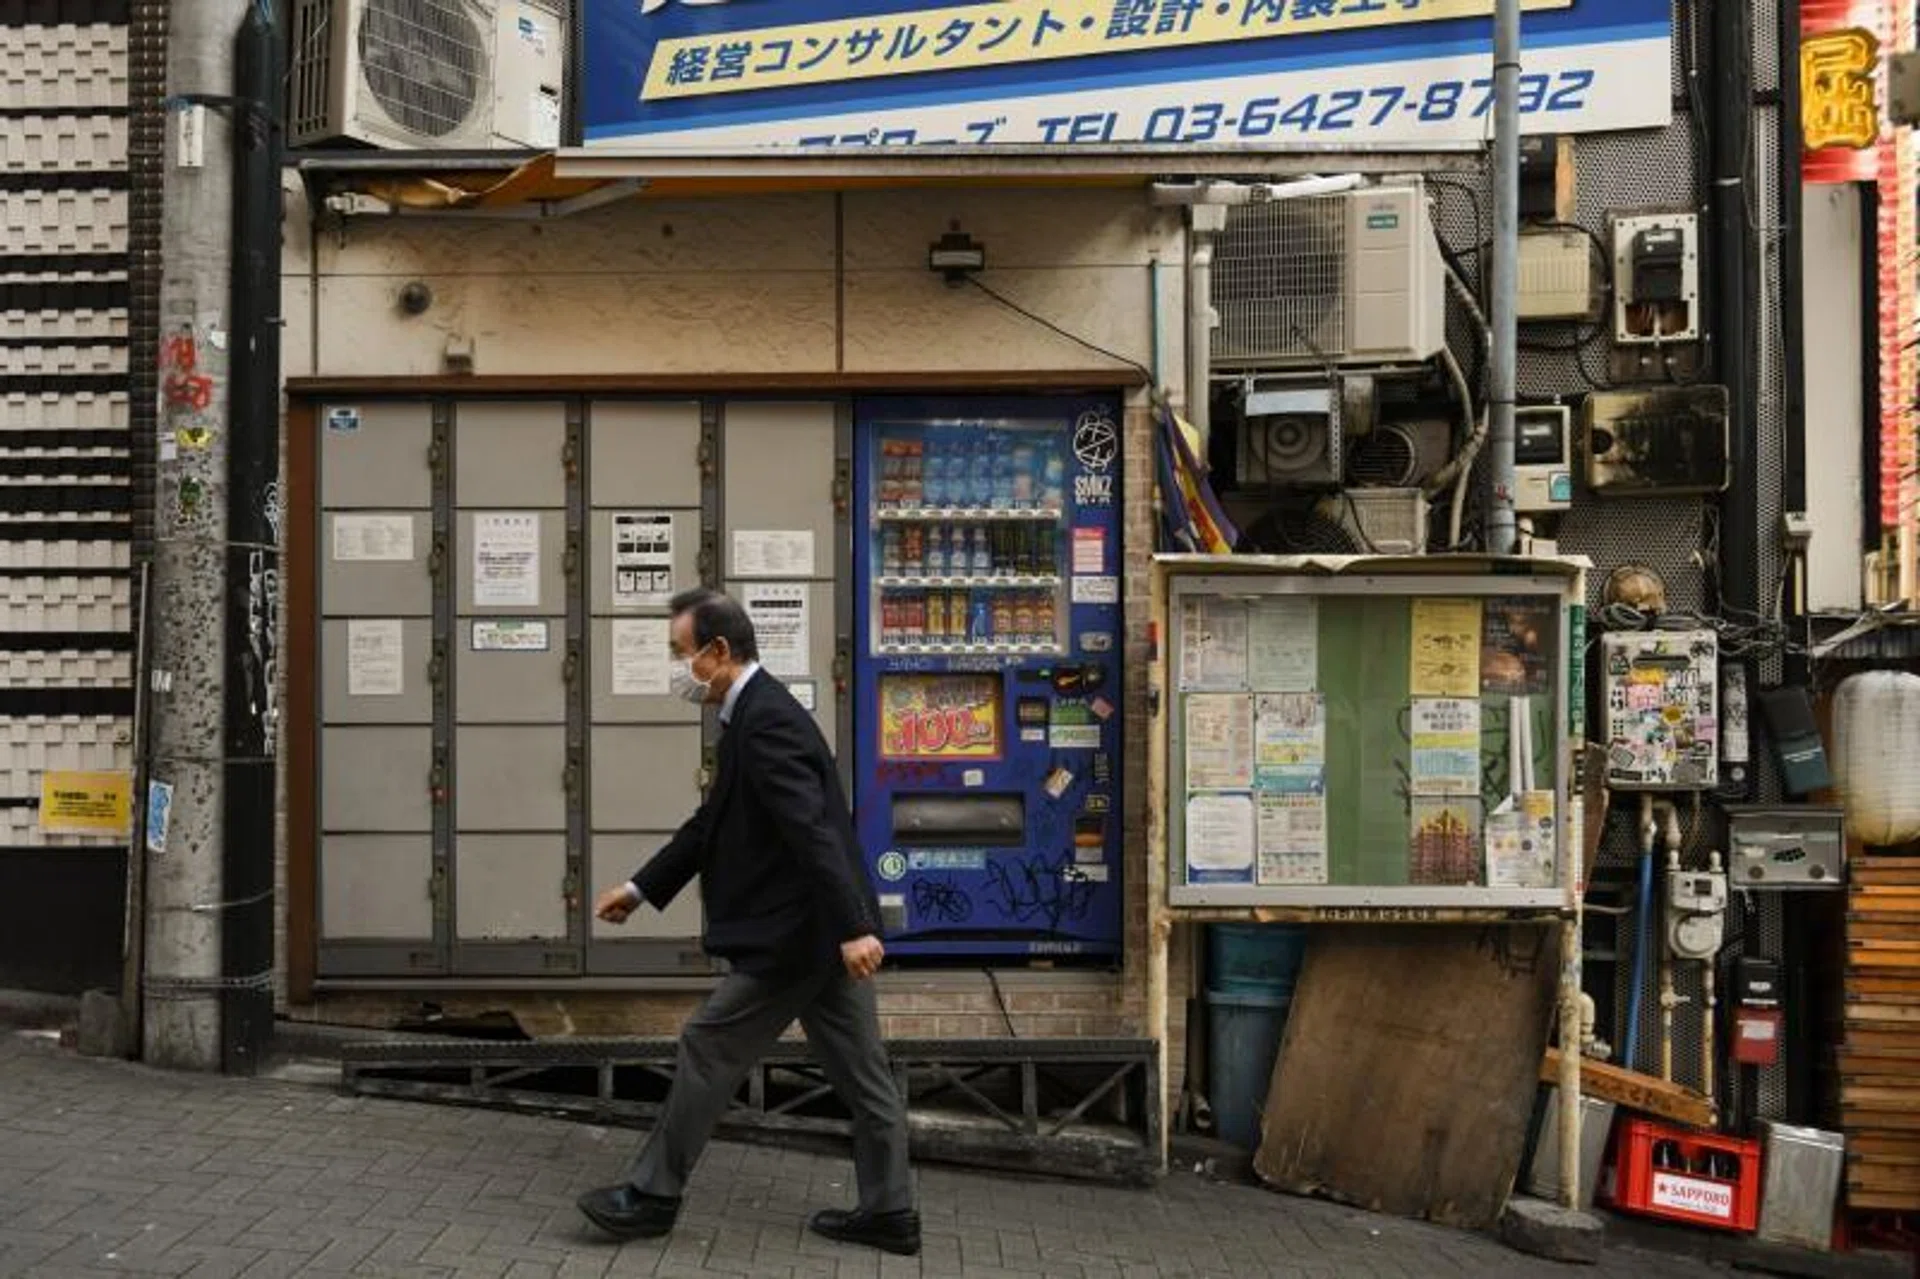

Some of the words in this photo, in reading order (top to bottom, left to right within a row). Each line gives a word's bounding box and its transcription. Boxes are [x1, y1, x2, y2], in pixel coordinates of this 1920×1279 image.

[666, 0, 1419, 86] 経営コンサルタント・設計・内
[1671, 1183, 1730, 1207] SAPPORO
